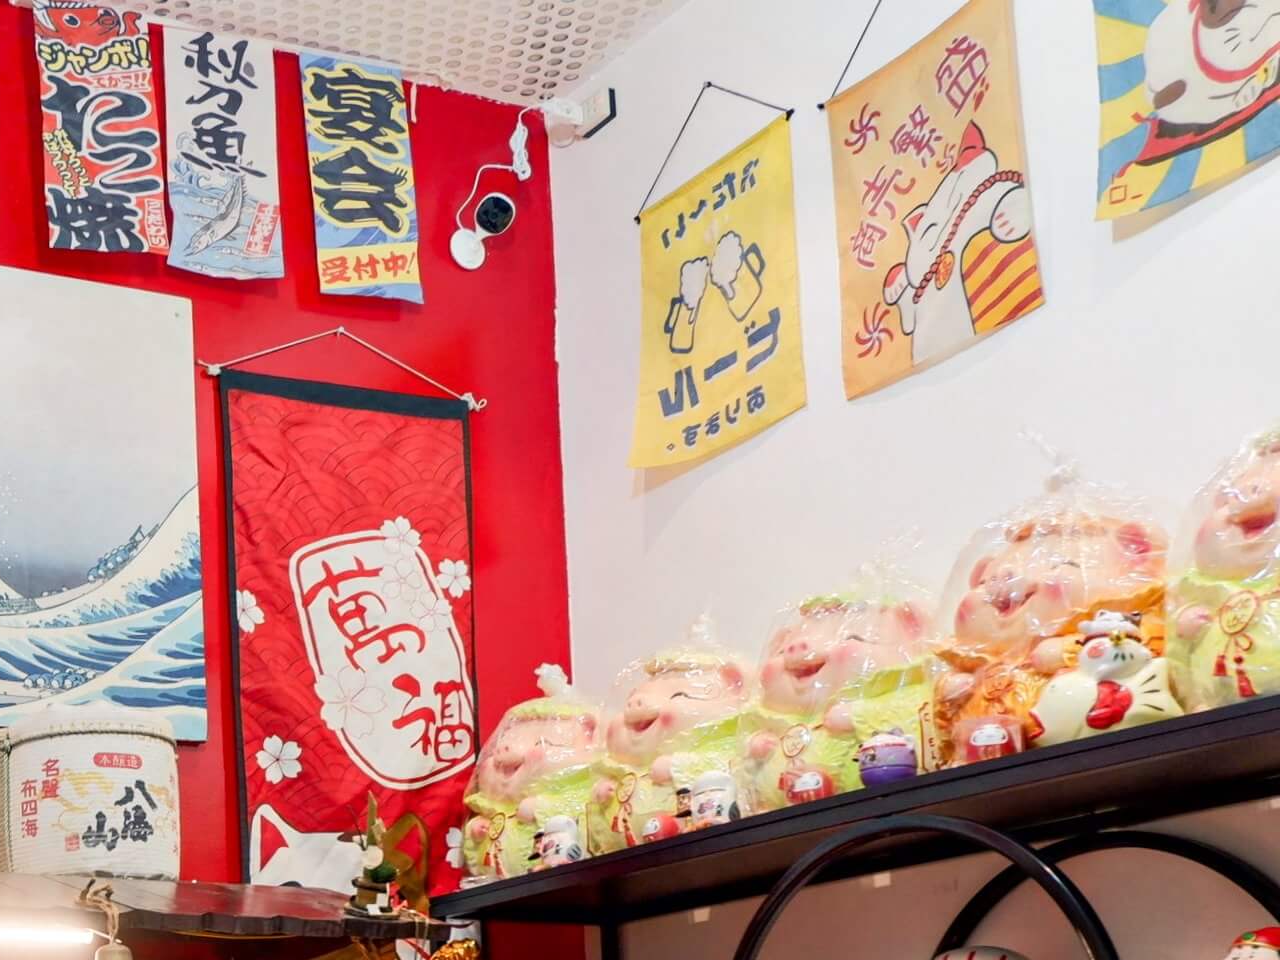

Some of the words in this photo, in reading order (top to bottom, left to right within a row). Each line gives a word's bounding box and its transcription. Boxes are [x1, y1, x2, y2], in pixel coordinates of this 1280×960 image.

[183, 31, 267, 178] 秋刀魚
[308, 68, 407, 233] 宴会
[321, 251, 416, 284] 受付中!
[21, 779, 39, 838] 布四海
